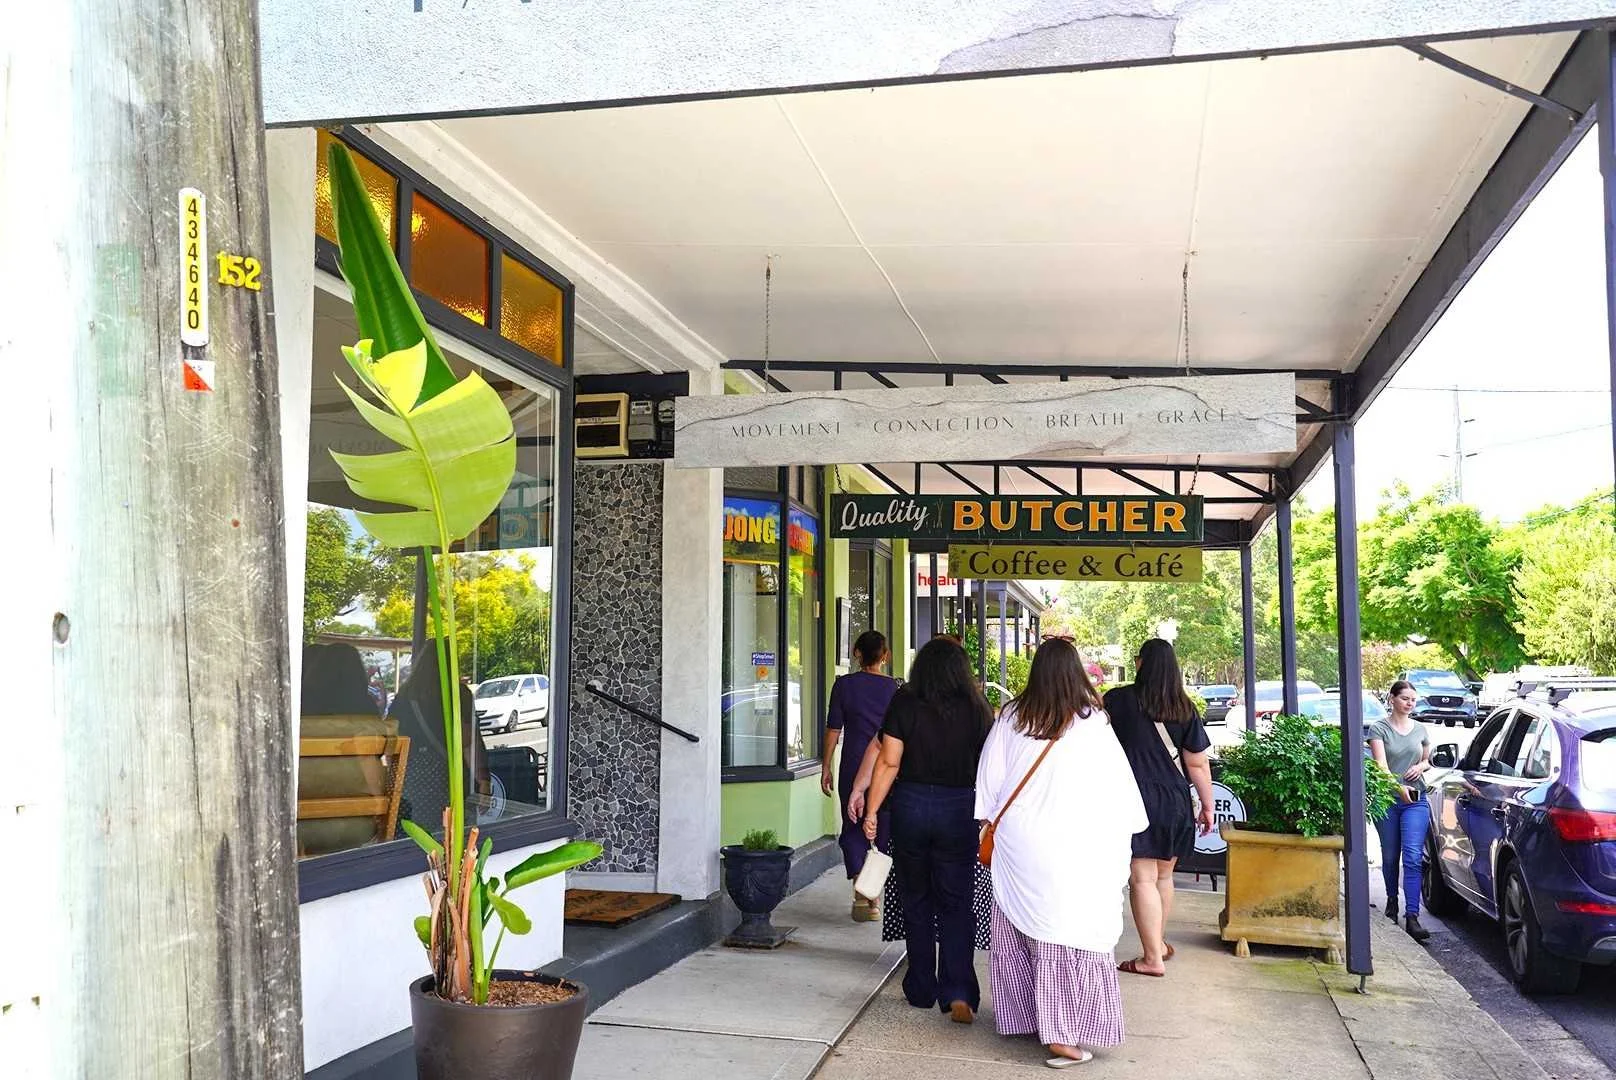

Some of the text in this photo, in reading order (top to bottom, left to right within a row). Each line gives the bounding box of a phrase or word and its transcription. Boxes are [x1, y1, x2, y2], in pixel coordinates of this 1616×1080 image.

[187, 198, 199, 329] 434640
[216, 250, 262, 291] 152
[732, 408, 1228, 439] MOVEMENT CONNECTION BREATH GRACE
[840, 499, 1187, 532] Quality BUTCHER
[917, 572, 965, 586] healt
[969, 550, 1184, 578] Coffee & Café
